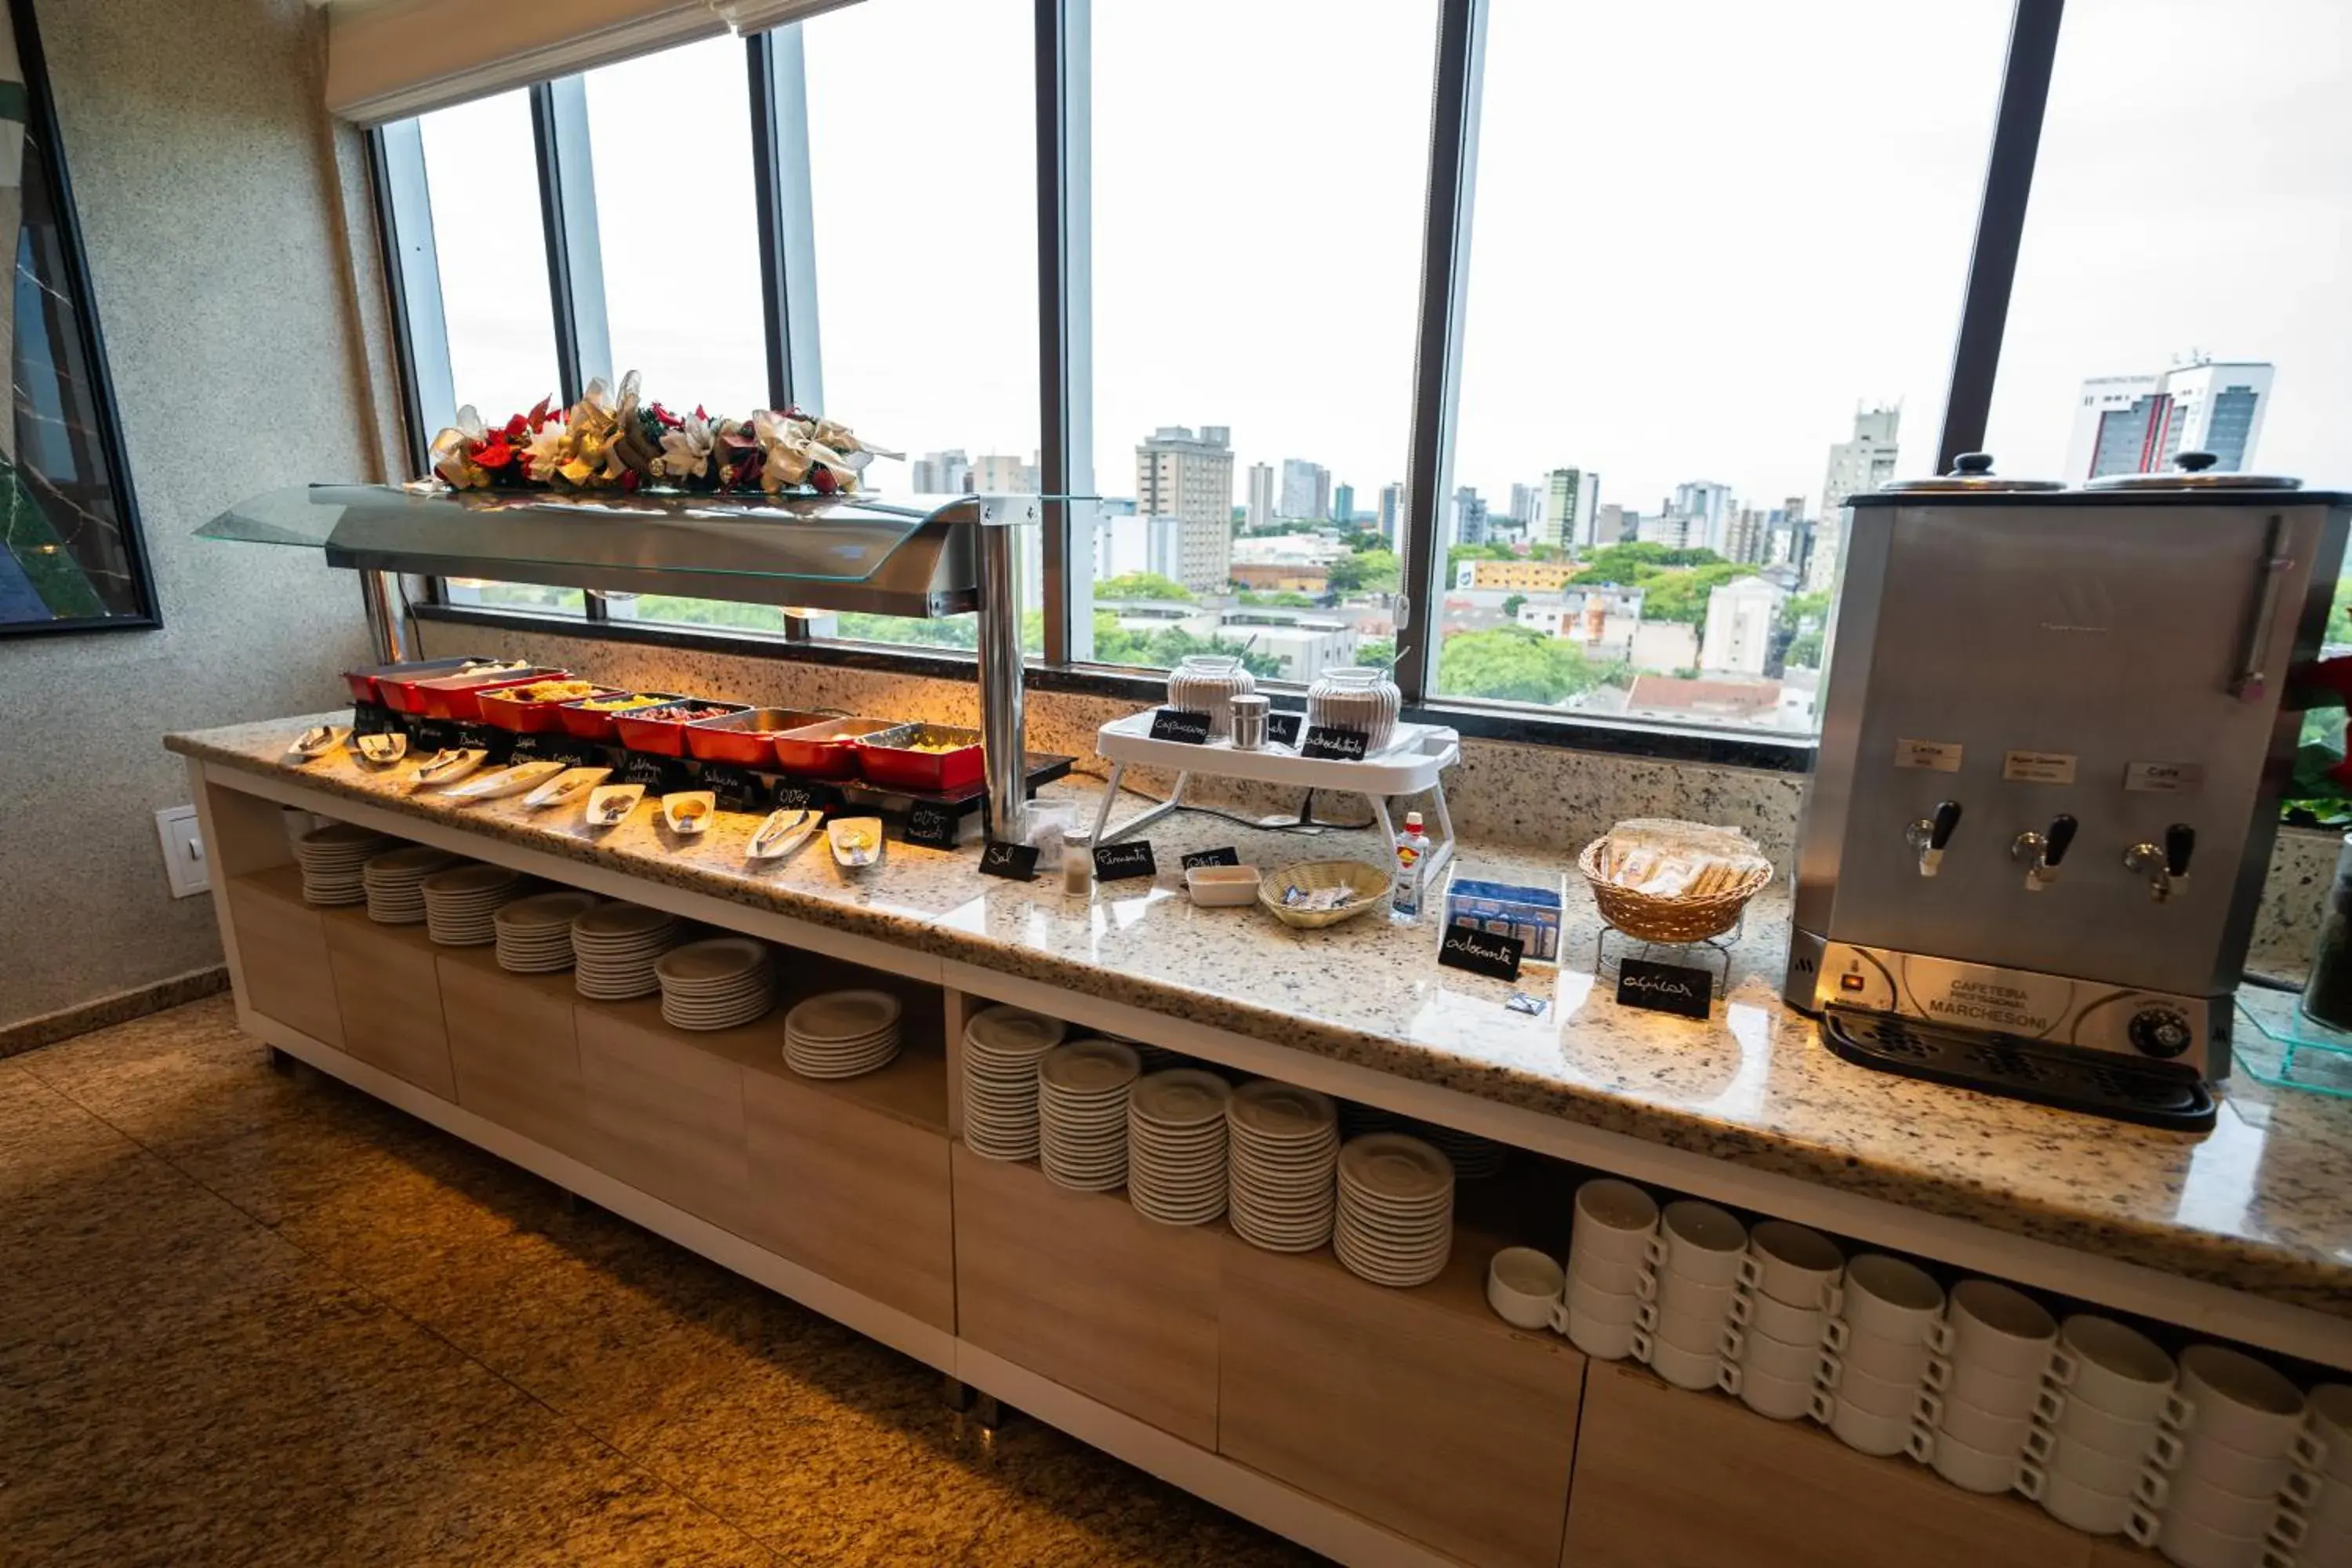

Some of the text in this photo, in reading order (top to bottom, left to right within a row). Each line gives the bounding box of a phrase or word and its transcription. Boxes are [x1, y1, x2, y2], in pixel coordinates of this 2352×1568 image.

[989, 846, 1014, 866] Sal
[1951, 979, 2028, 1000] CAFETEIRA
[1929, 999, 2048, 1030] MARCHESONI
